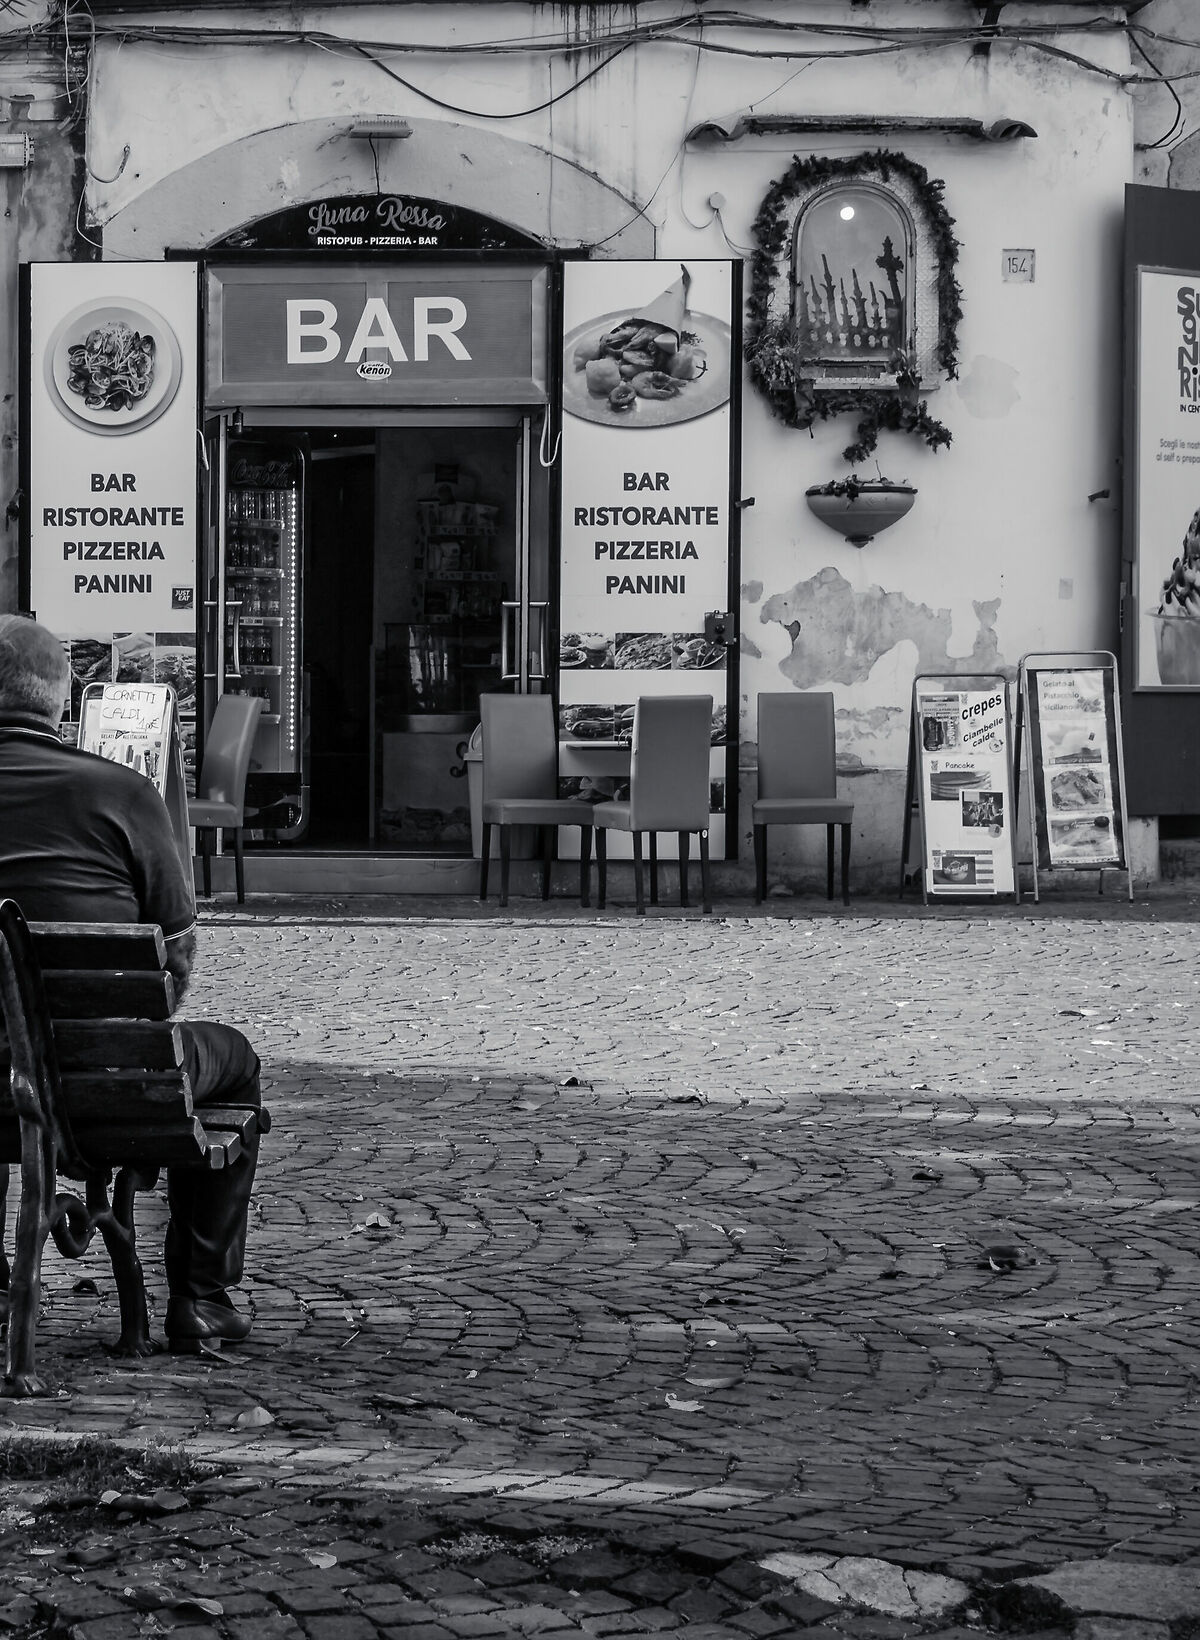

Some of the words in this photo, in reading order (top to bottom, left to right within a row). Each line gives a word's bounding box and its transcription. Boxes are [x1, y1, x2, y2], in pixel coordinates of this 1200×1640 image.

[308, 203, 369, 234] Luna
[376, 197, 447, 231] Rossa
[317, 236, 363, 245] RISTOPUB
[370, 236, 412, 245] PIZZERIA
[418, 236, 438, 245] BAR
[1008, 257, 1028, 273] 154
[286, 296, 472, 364] BAR
[91, 473, 136, 492] BAR
[623, 472, 670, 491] BAR
[43, 507, 184, 526] RISTORANTE
[574, 506, 719, 526] RISTORANTE
[63, 541, 165, 560] PIZZERIA
[594, 541, 699, 560] PIZZERIA
[74, 574, 152, 593] PANINI
[606, 575, 685, 594] PANINI
[105, 685, 156, 704] CORNETTI
[103, 707, 140, 719] CALDI
[961, 694, 1002, 720] crepes
[963, 717, 1004, 742] Ciambelle
[972, 731, 995, 747] calde
[945, 761, 975, 769] Pancake
